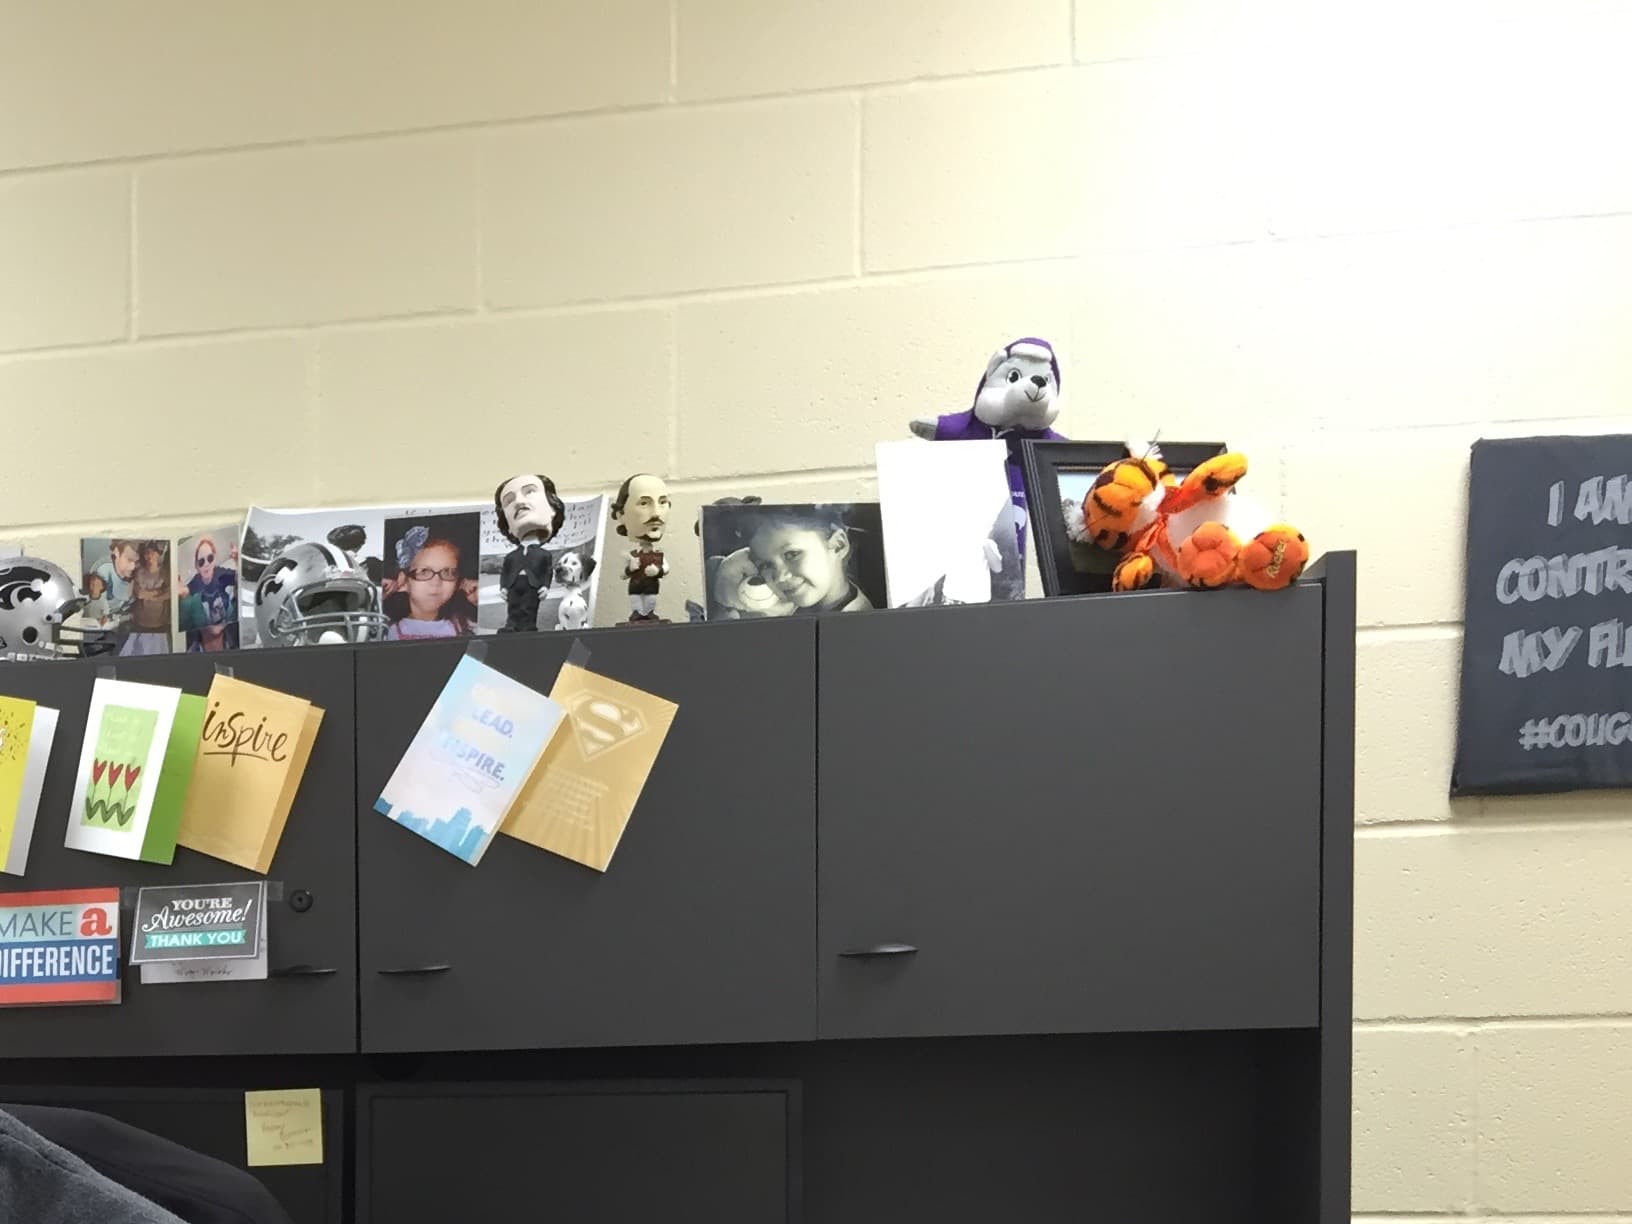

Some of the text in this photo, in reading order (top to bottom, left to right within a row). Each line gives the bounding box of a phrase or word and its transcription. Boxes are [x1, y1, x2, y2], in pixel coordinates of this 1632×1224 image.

[1547, 480, 1565, 527] I
[1496, 545, 1632, 604] CONTR
[1499, 625, 1584, 679] MY
[201, 700, 289, 768] inspire
[1518, 711, 1632, 751] #COUG
[79, 907, 113, 937] a
[141, 899, 253, 933] Awesome!
[171, 897, 233, 912] YOU'RE
[149, 930, 242, 947] THANK YOU
